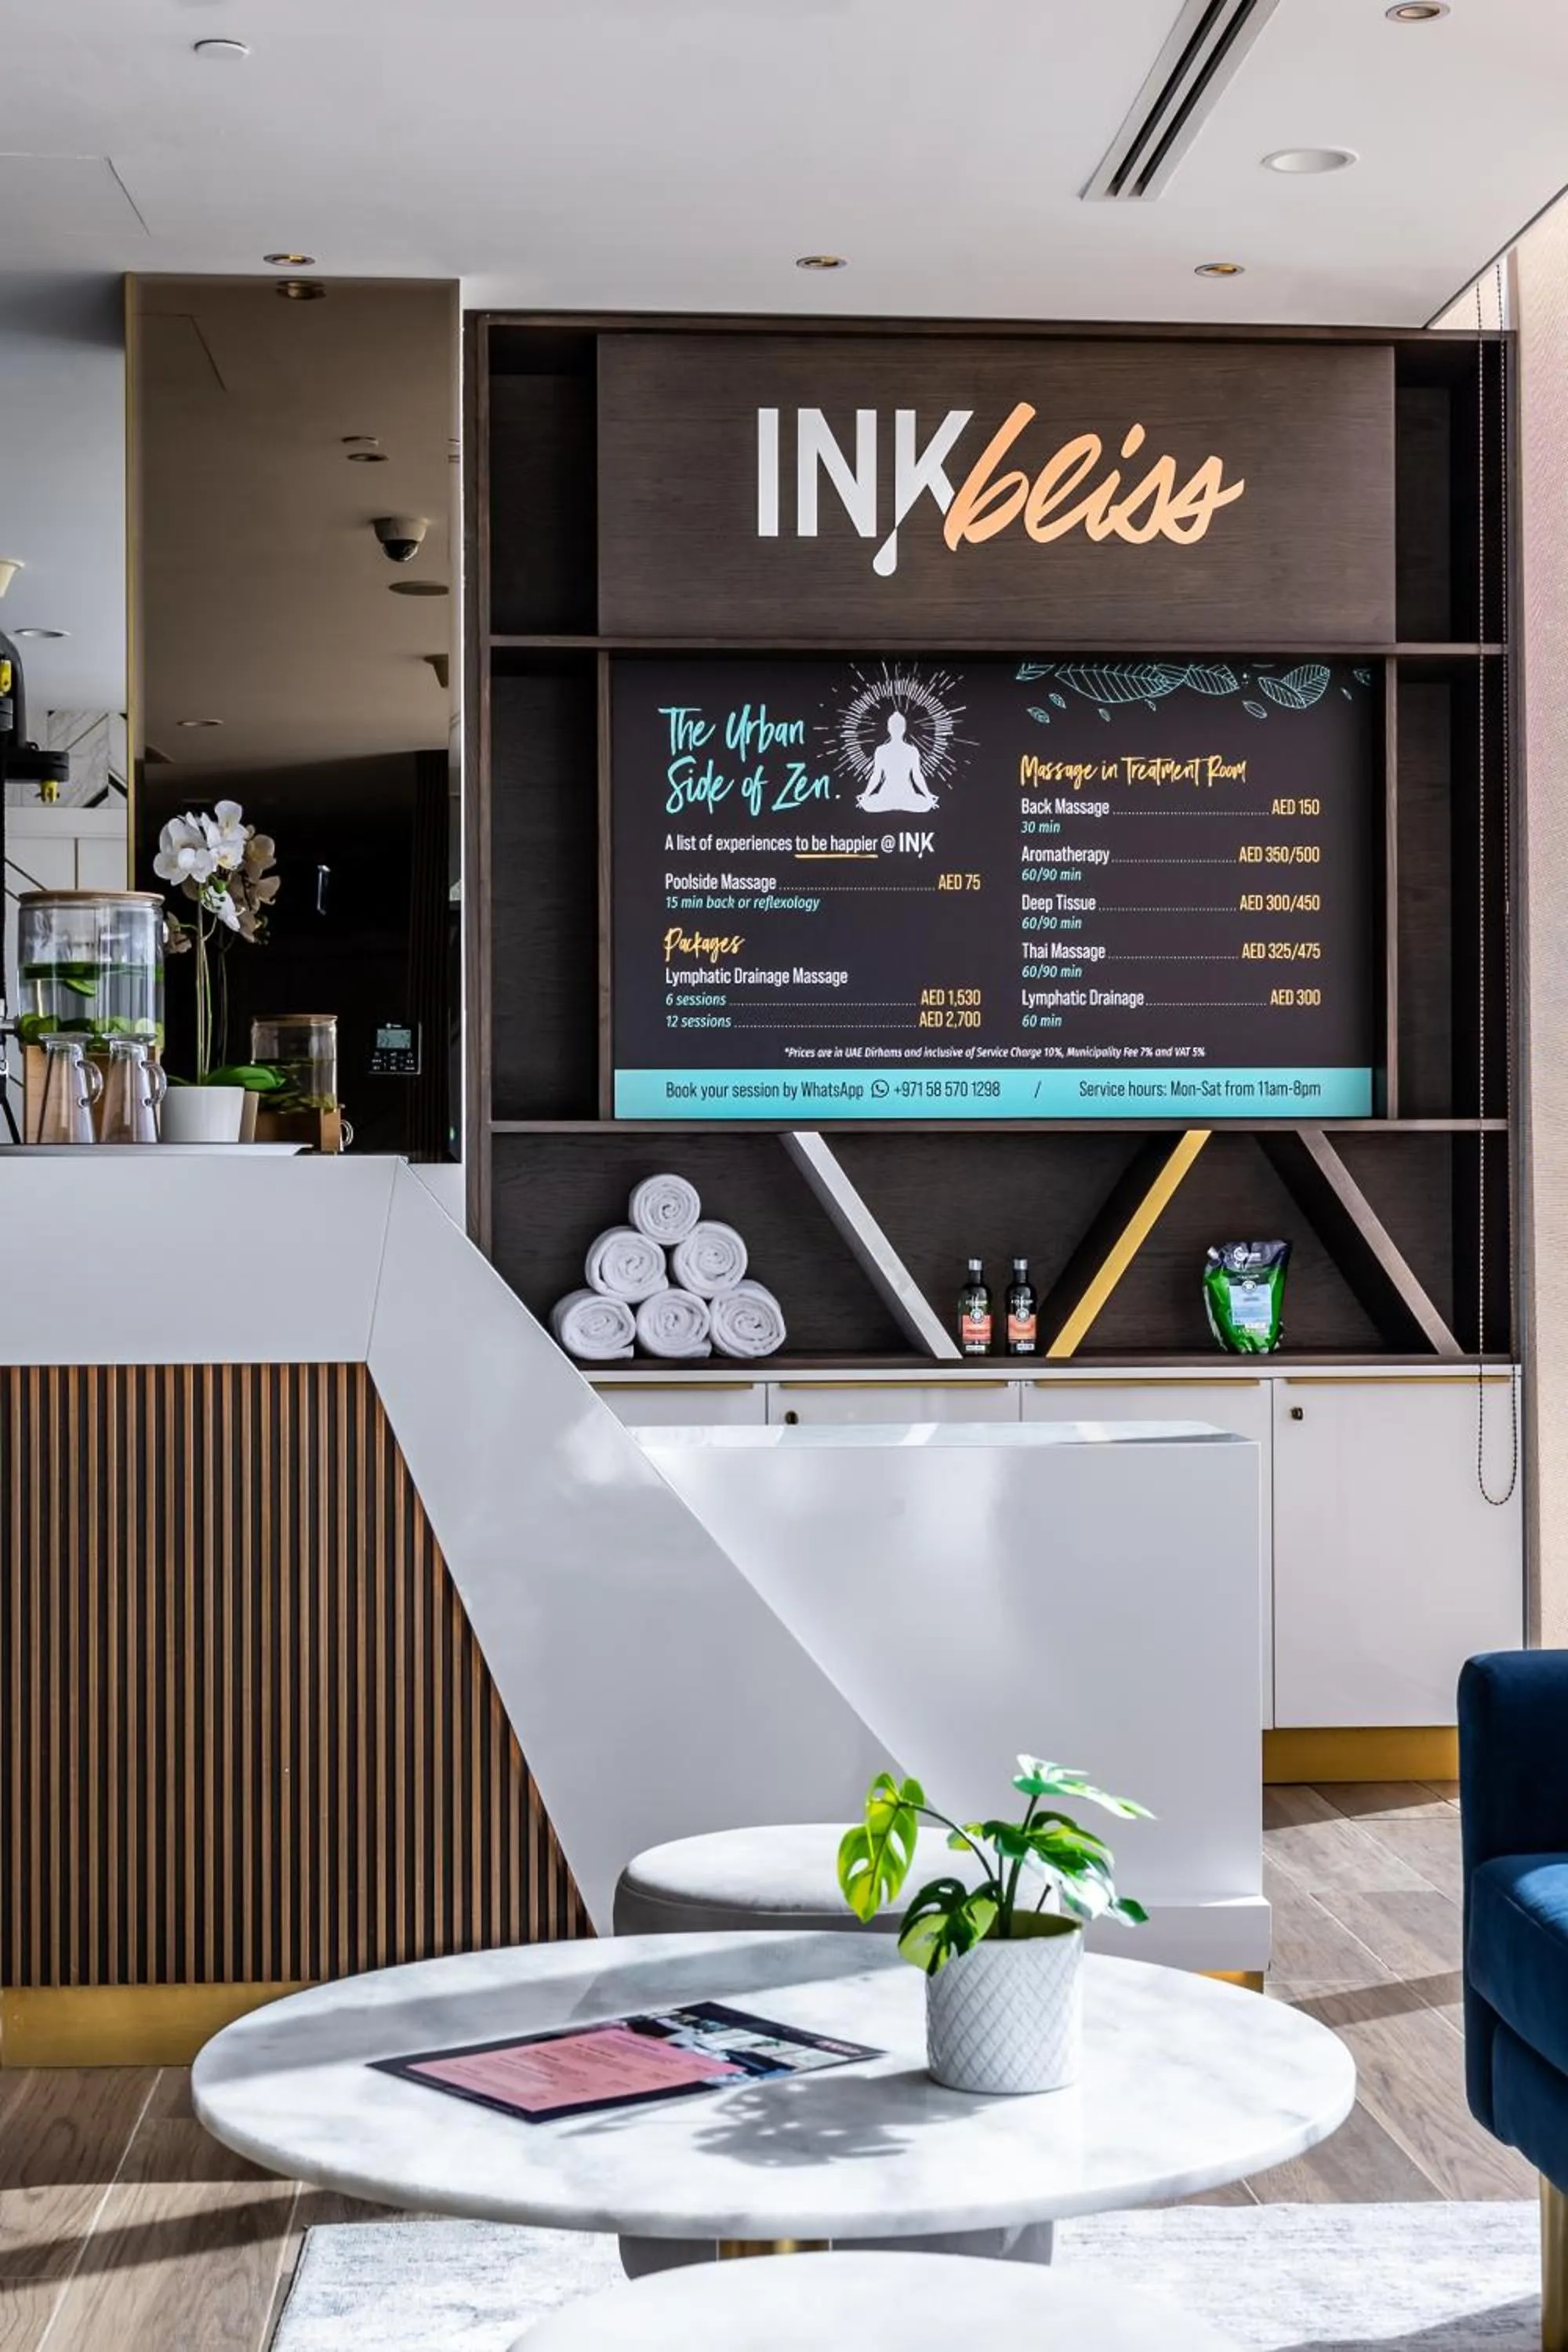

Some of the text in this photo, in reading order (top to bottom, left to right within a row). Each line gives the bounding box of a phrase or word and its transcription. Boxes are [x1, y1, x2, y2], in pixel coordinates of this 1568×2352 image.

[943, 401, 1244, 551] bliss
[658, 704, 804, 761] The Urban
[1020, 754, 1098, 789] Massage
[1102, 760, 1117, 780] in
[665, 756, 734, 815] Side
[742, 765, 768, 816] of
[1022, 798, 1109, 817] Back Massage
[1272, 799, 1319, 815] AED 150
[1022, 820, 1060, 833] 30 min
[665, 834, 673, 851] A
[677, 834, 696, 851] list
[699, 834, 713, 851] of
[716, 834, 792, 853] experiences
[795, 834, 808, 851] to
[811, 834, 828, 851] be
[830, 834, 877, 854] happier
[898, 832, 935, 859] INK
[1022, 847, 1109, 866] Aromatherapy
[1239, 848, 1319, 863] AED 350/500
[938, 875, 981, 890] AED 75
[1022, 868, 1081, 881] 60/90 min
[666, 874, 776, 893] Poolside Massage
[666, 896, 820, 912] 15 min back or reflexology
[1022, 895, 1096, 913] Deep Tissue
[1240, 895, 1320, 911] AED 300/450
[1022, 916, 1082, 930] 60/90 min
[664, 927, 745, 963] Packages
[1022, 943, 1105, 961] Thai Massage
[1242, 943, 1320, 959] AED 325/475
[666, 968, 848, 987] Lymphatic Drainage Massage
[1022, 965, 1082, 978] 60/90 min
[666, 993, 727, 1006] 6 sessions
[921, 990, 981, 1007] AED 1,530
[1022, 989, 1144, 1008] Lymphatic Drainage
[1270, 989, 1320, 1005] AED 300
[666, 1015, 731, 1028] 12 sessions
[919, 1011, 981, 1029] AED 2,700
[1022, 1014, 1062, 1027] 60 min
[817, 1049, 832, 1058] are
[835, 1047, 843, 1058] in
[845, 1047, 863, 1057] UAE
[865, 1047, 902, 1058] Dirhams
[905, 1047, 922, 1058] and
[924, 1047, 964, 1058] inclusive
[965, 1047, 975, 1060] of
[976, 1047, 1007, 1058] Service
[1010, 1048, 1041, 1060] Charge
[1066, 1047, 1121, 1059] Municipality
[1123, 1047, 1139, 1057] Fee
[1141, 1047, 1153, 1057] 7%
[1156, 1047, 1173, 1057] and
[1174, 1047, 1190, 1057] VAT
[1192, 1047, 1205, 1057] 5%
[666, 1082, 1000, 1100] Book your session by WhatsApp +971 58 570 1298
[1080, 1081, 1321, 1099] Service hours: Mon-Sat from 11am-8pm
